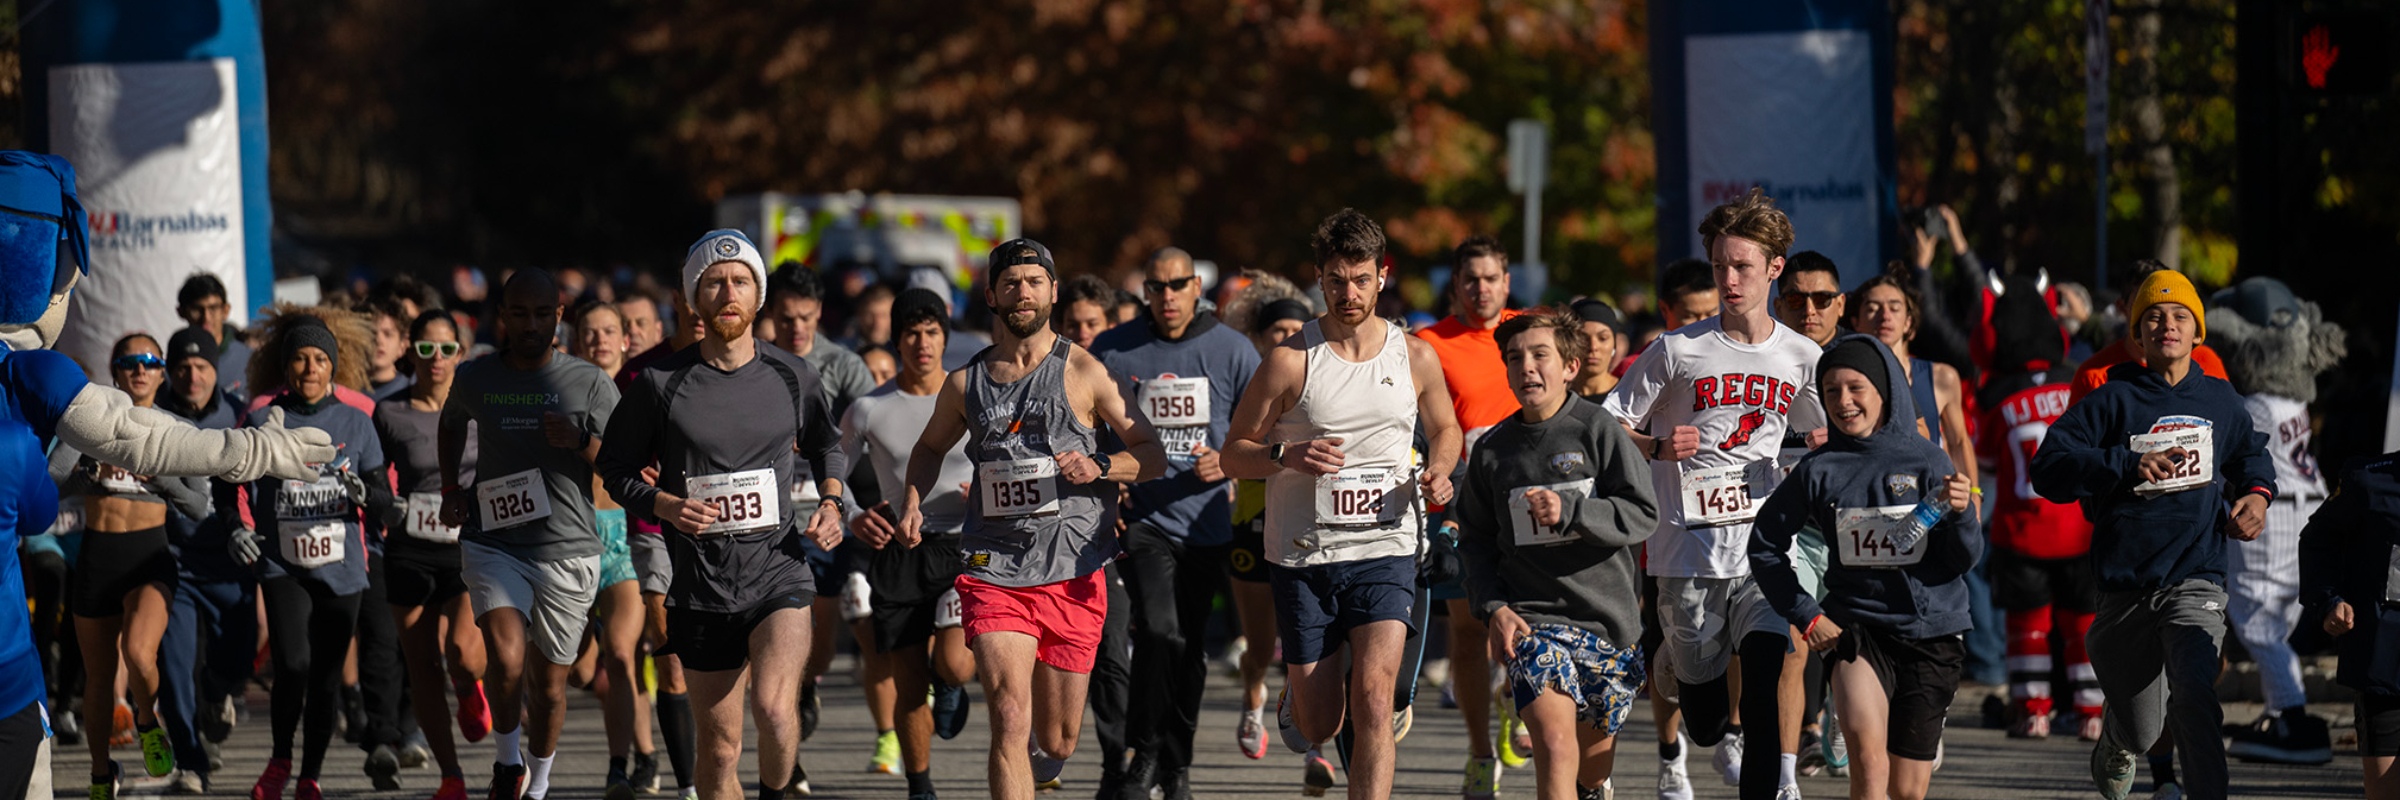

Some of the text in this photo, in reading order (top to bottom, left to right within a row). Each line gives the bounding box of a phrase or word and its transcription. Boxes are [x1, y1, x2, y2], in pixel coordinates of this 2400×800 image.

[88, 209, 228, 234] WJBarnabas
[483, 393, 559, 405] FINISHER24
[1149, 396, 1195, 418] 1358
[1693, 373, 1796, 416] REGIS
[979, 402, 1017, 426] SOMA
[2167, 449, 2200, 479] 22
[489, 490, 535, 521] 1326
[992, 479, 1041, 507] 1335
[1331, 488, 1382, 516] 1023
[1696, 484, 1752, 516] 1430
[704, 492, 762, 523] 033
[293, 536, 331, 558] 1168
[1850, 529, 1914, 557] 144
